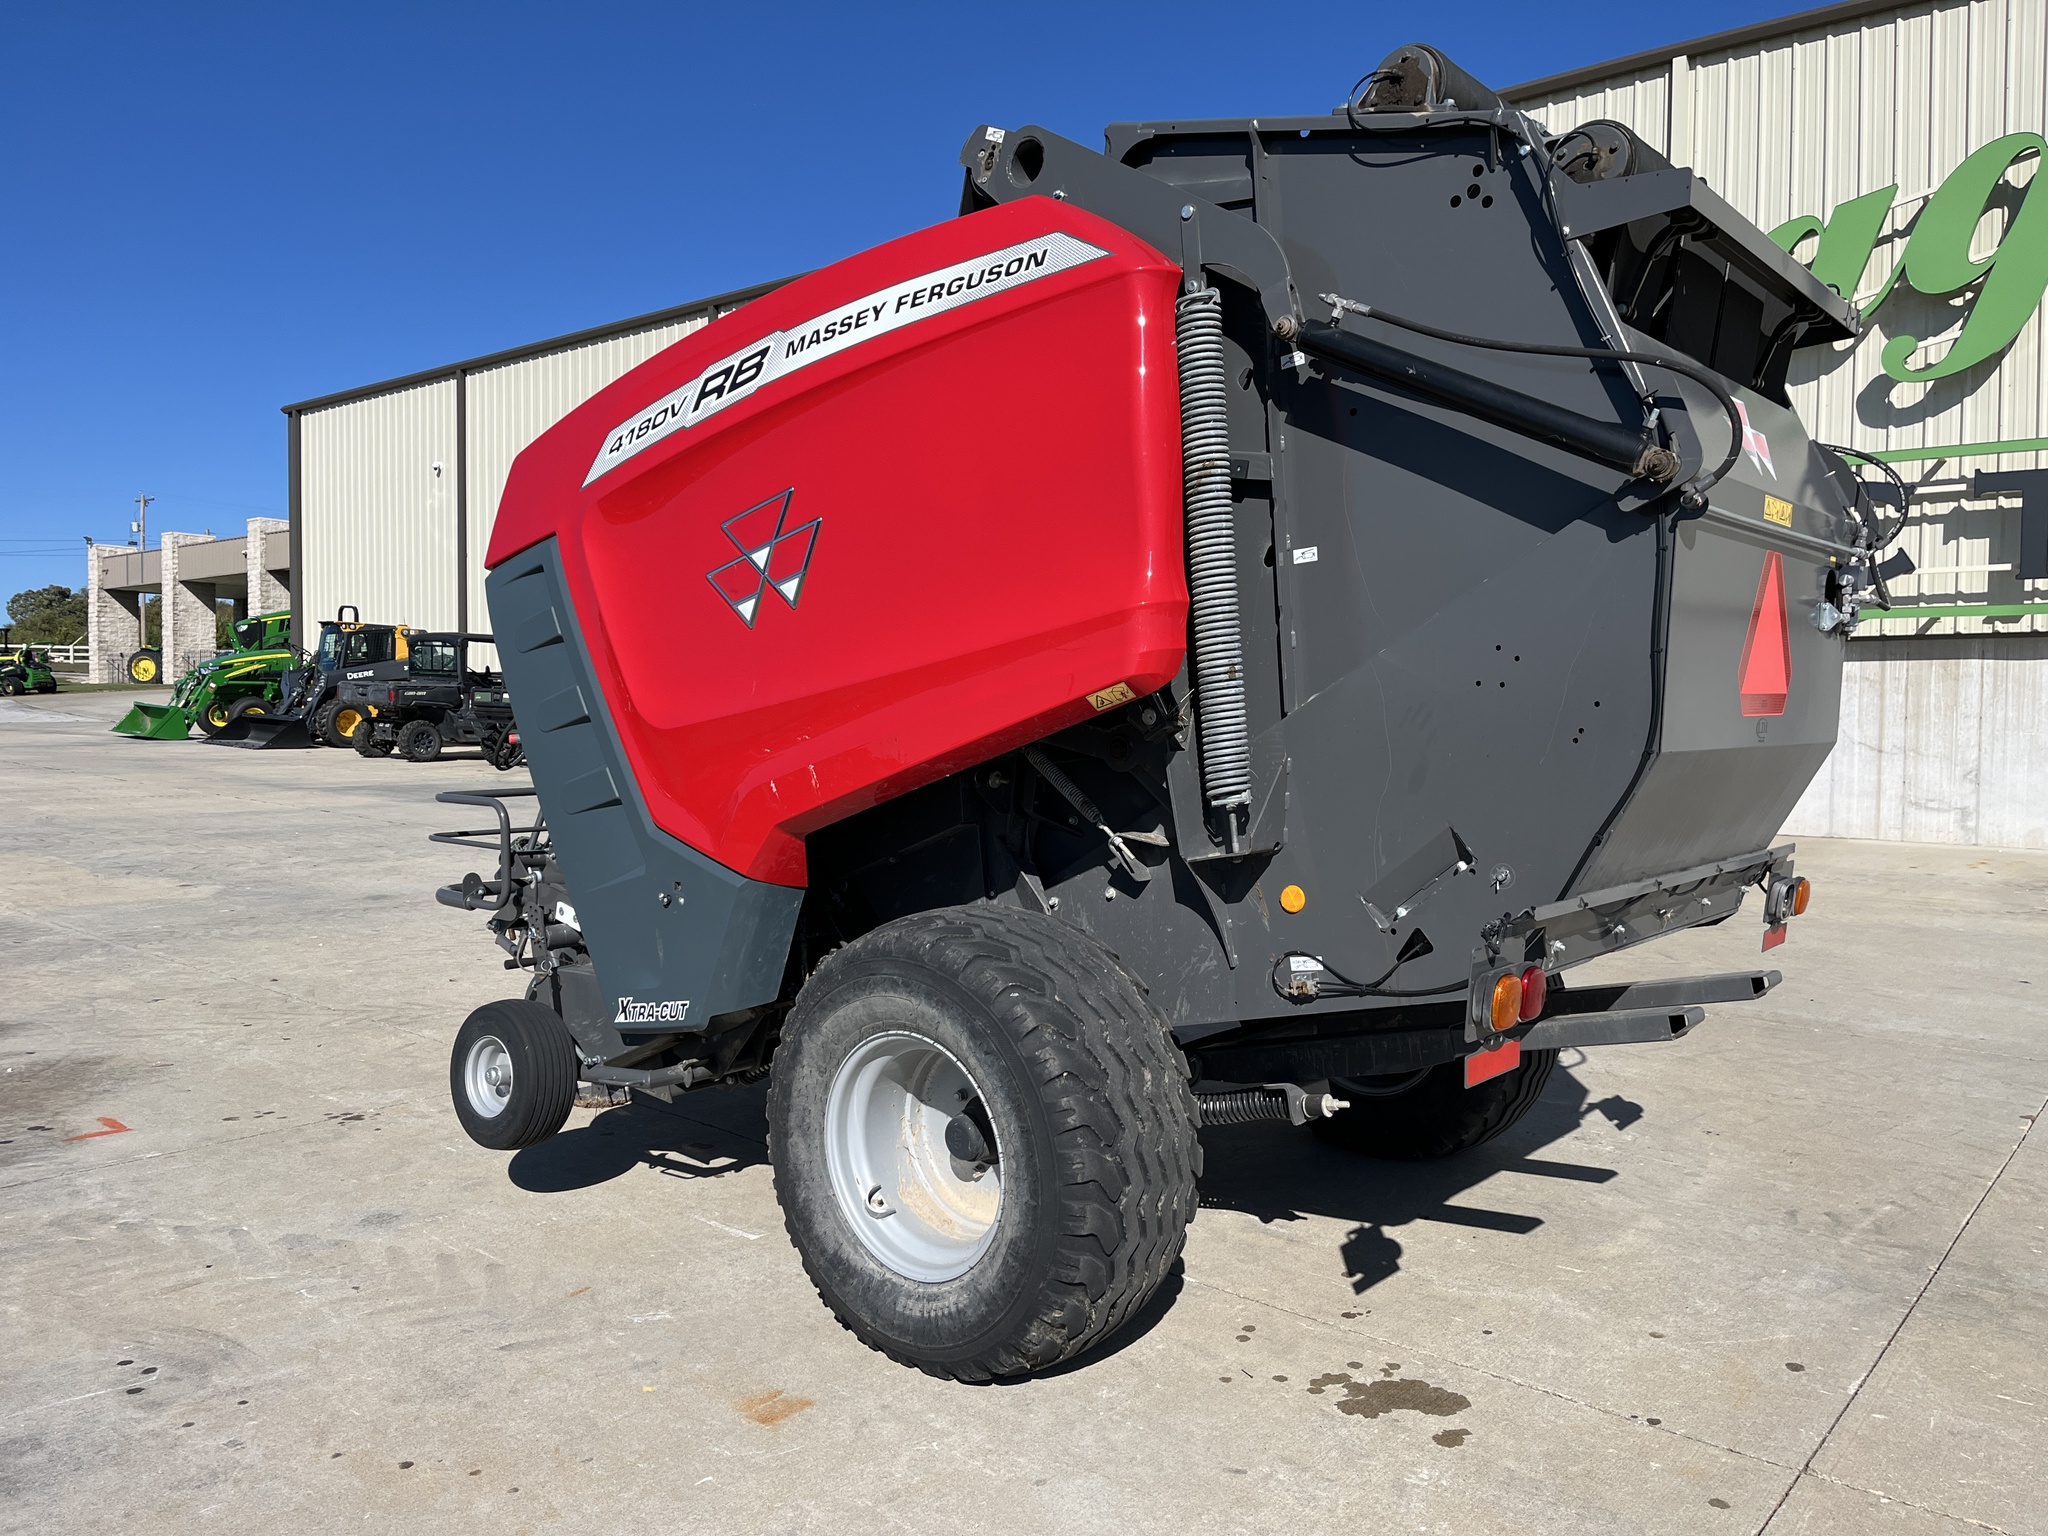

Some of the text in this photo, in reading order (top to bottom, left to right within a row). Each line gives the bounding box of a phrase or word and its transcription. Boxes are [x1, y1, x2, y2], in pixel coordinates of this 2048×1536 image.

[607, 248, 1049, 456] 4180V RB MASSEY FERGUSON
[346, 669, 374, 680] DEERE
